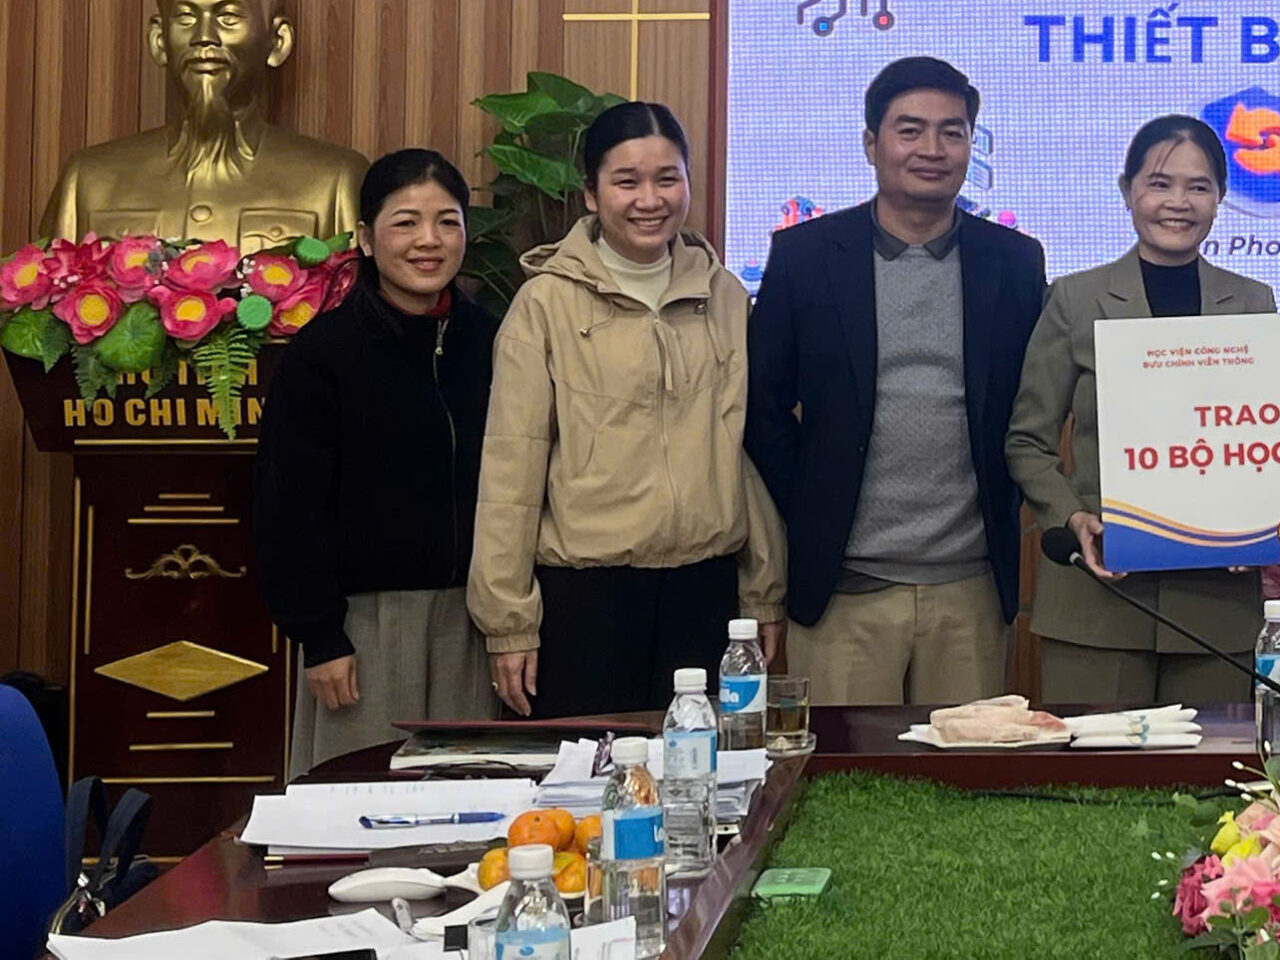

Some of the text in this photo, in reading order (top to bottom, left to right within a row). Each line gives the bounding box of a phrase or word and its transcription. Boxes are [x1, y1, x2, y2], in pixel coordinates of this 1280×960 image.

[1024, 2, 1218, 63] THIẾT
[195, 395, 266, 427] MIN
[1194, 403, 1280, 428] TRAO
[1123, 446, 1158, 471] 10
[1168, 439, 1214, 475] BỘ
